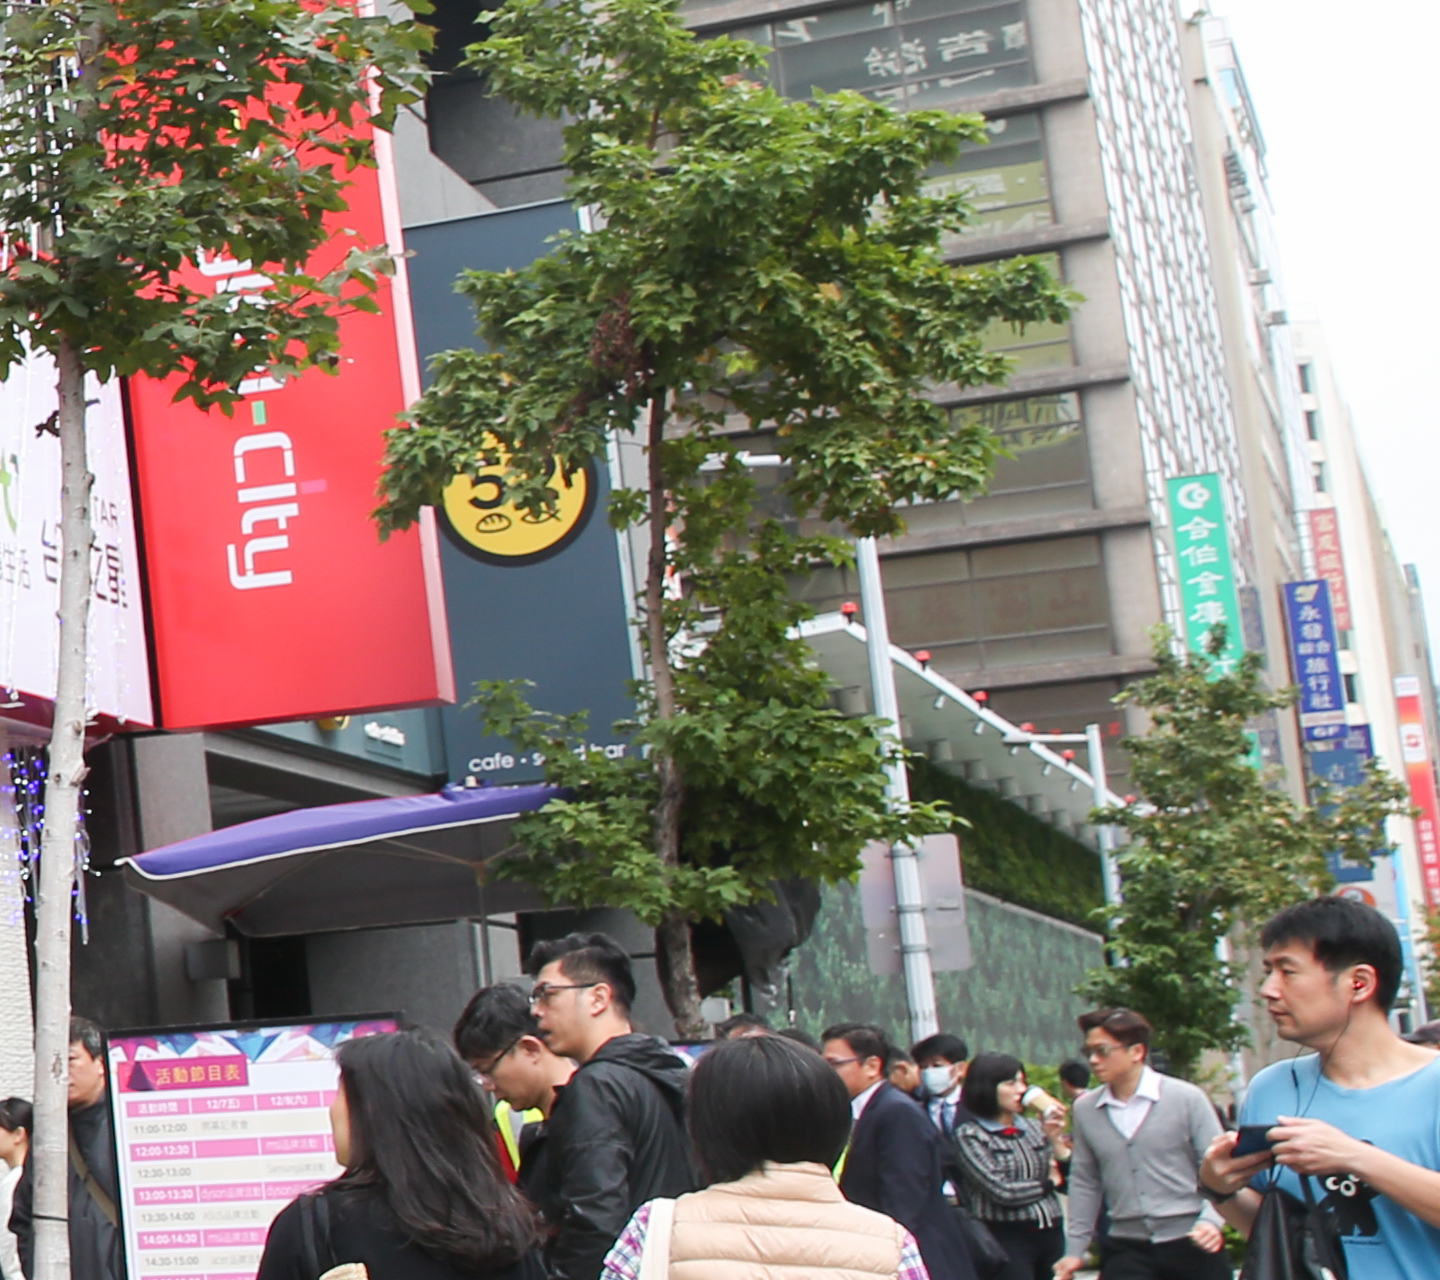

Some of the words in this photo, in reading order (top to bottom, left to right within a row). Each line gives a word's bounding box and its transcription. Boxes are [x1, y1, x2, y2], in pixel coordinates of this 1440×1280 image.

[468, 752, 515, 772] cafe
[155, 1064, 241, 1086] 活動節目表
[135, 1145, 190, 1157] 12:00-12:30
[138, 1189, 194, 1201] 13:00-13:30
[142, 1233, 198, 1245] 14:00-14:30
